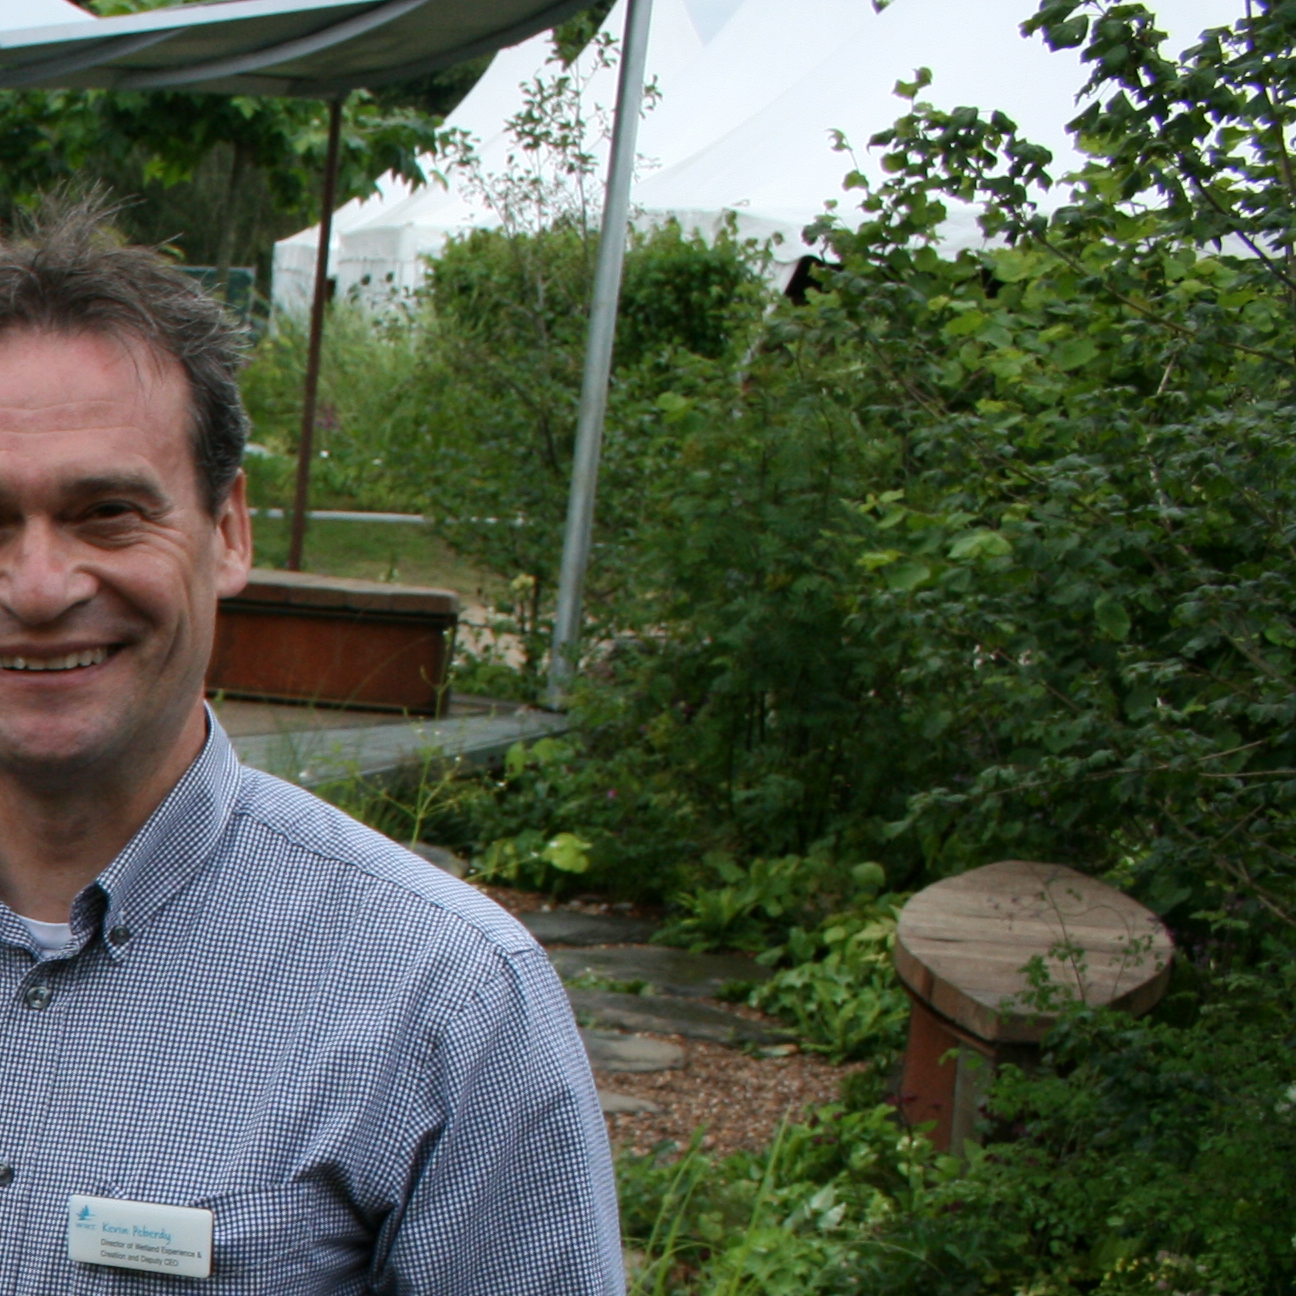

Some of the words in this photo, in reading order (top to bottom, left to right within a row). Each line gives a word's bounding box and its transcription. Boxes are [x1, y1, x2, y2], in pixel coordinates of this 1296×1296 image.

[102, 1222, 129, 1234] Kevin
[100, 1238, 125, 1249] Director
[140, 1254, 163, 1266] Deputy
[163, 1258, 179, 1267] CEO
